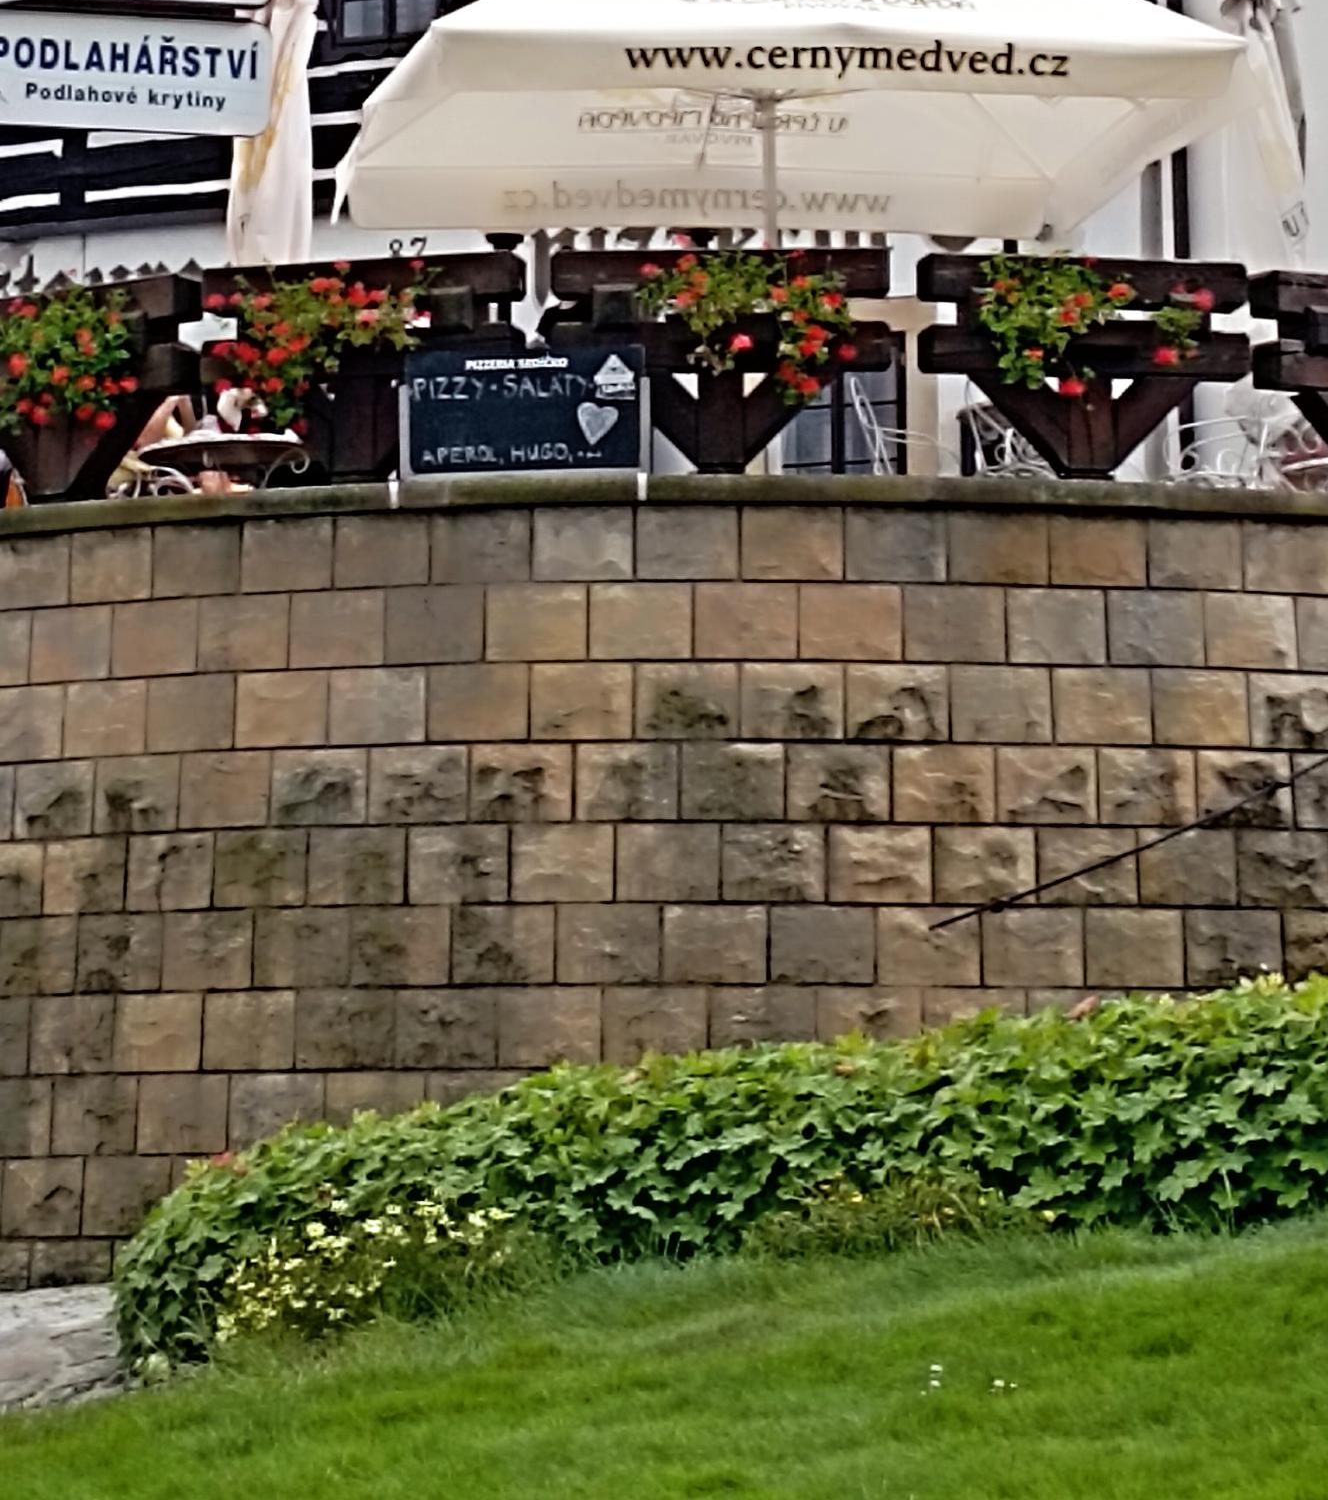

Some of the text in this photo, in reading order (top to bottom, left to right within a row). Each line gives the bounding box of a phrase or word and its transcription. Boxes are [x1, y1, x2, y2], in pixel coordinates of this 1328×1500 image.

[626, 39, 1070, 80] www.cernymedved.cz
[25, 83, 226, 112] Podlahové krytiny
